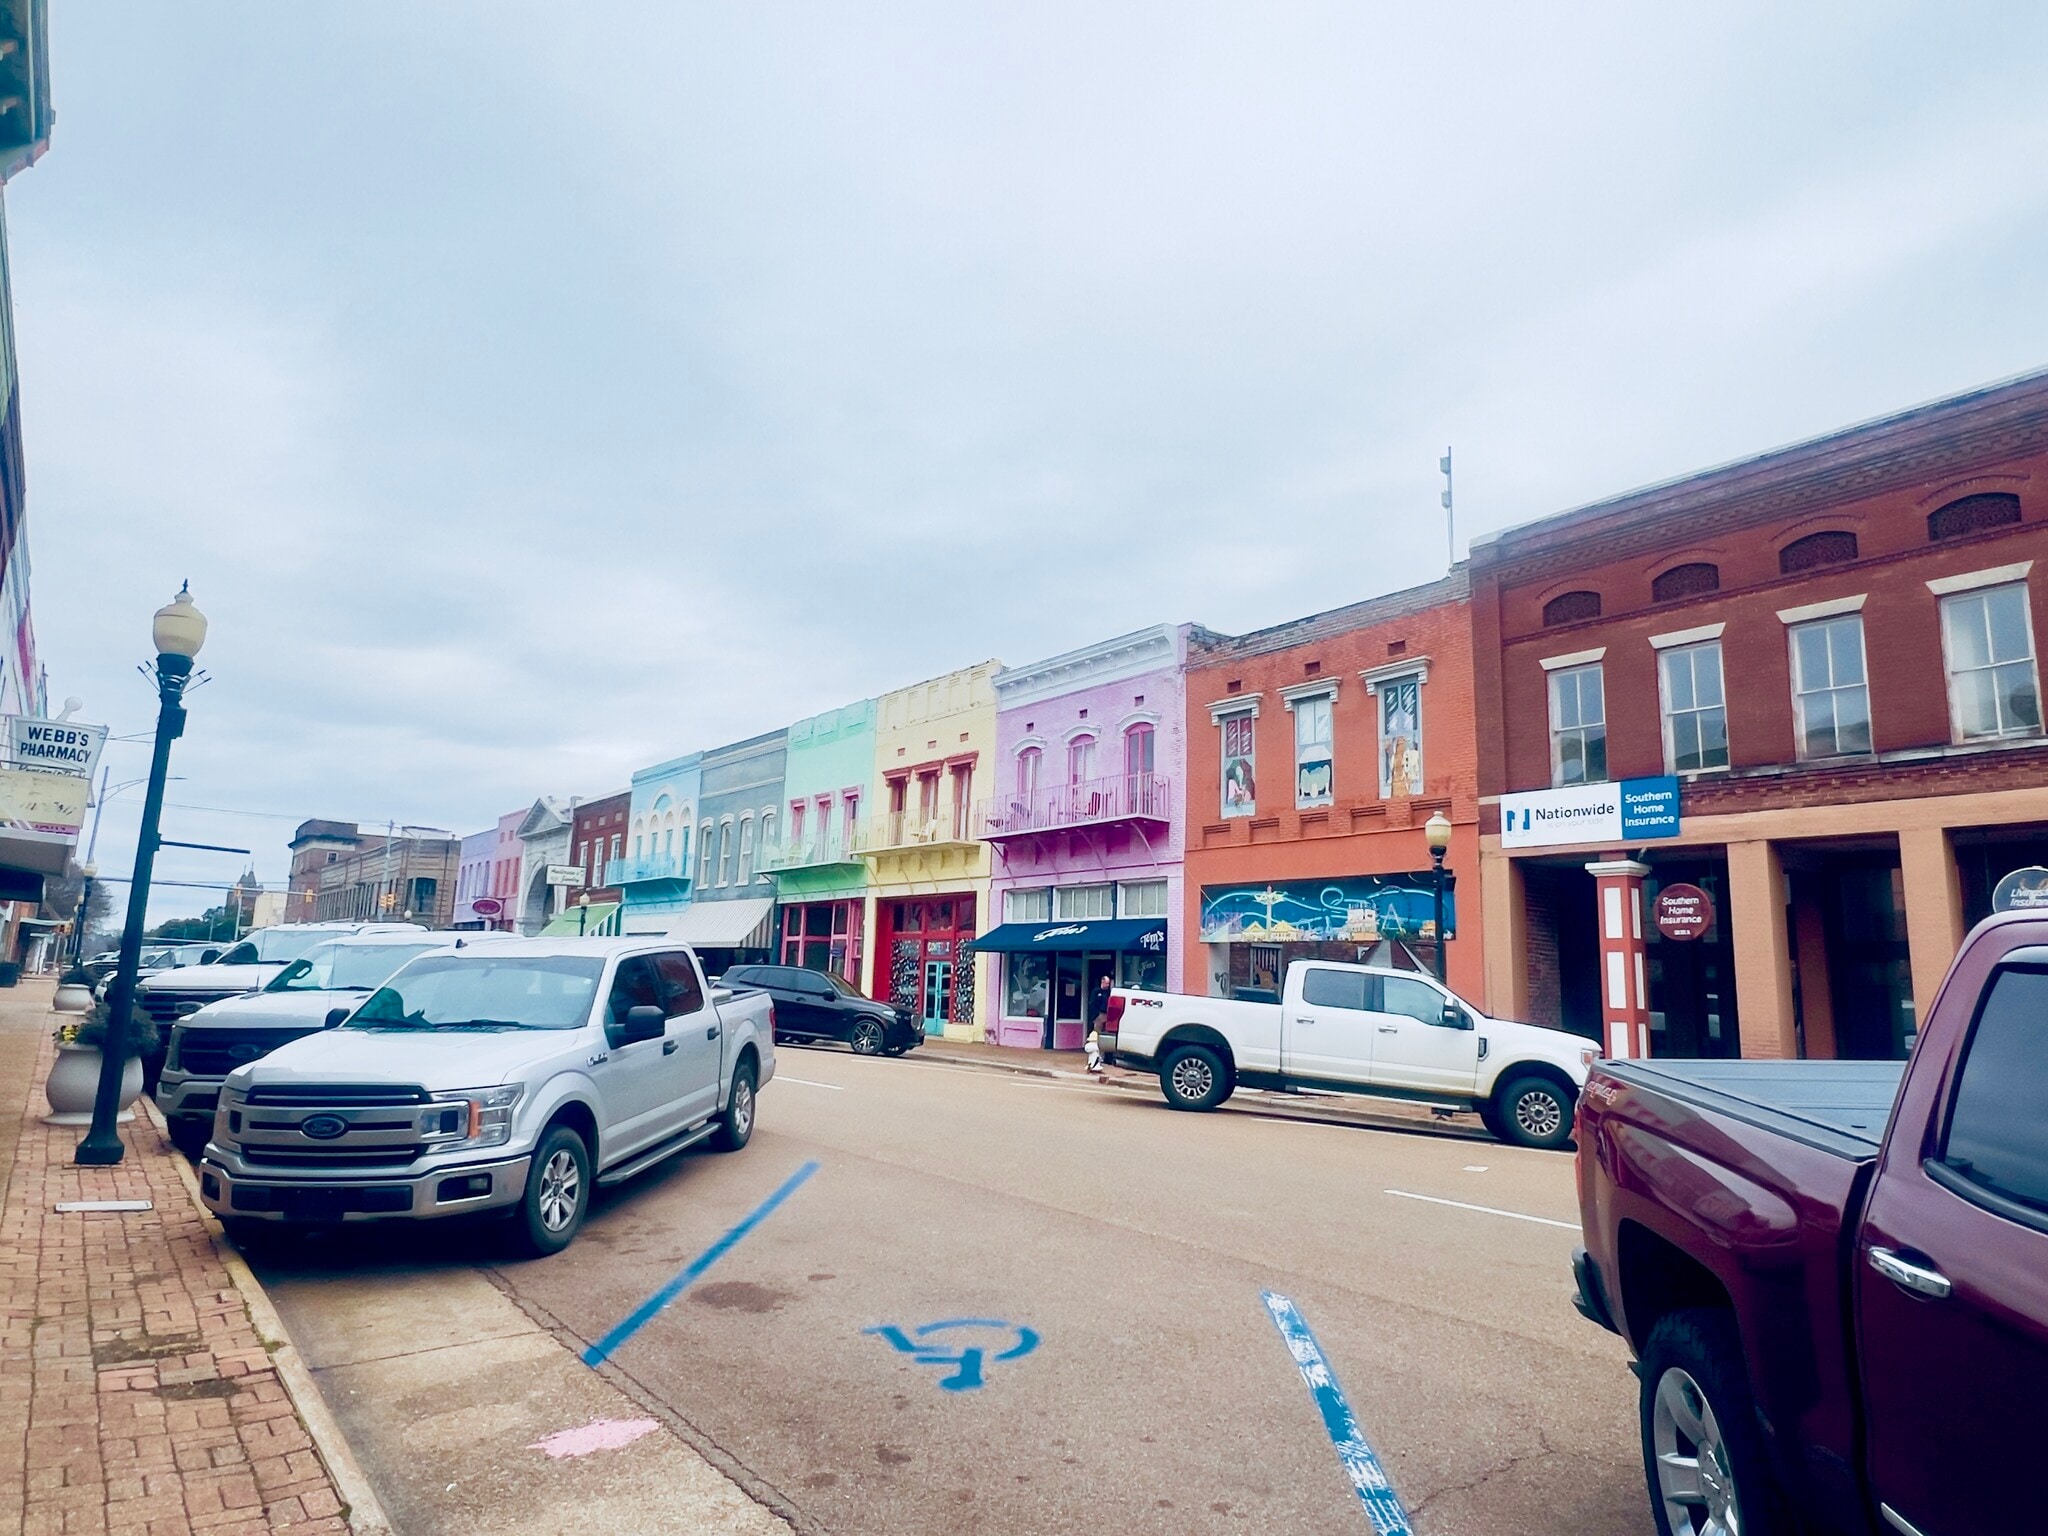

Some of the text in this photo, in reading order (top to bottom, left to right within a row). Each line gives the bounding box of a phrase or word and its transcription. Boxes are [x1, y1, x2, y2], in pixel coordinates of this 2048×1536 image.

[28, 726, 89, 747] WEBB'S
[20, 742, 92, 764] PHARMACY
[1625, 791, 1672, 804] Southern
[1535, 803, 1615, 821] Nationwide
[1633, 803, 1664, 814] Home
[1625, 815, 1675, 828] Insurance
[1662, 896, 1700, 906] Southern
[1668, 906, 1694, 915] Home
[1660, 915, 1702, 925] Insurance
